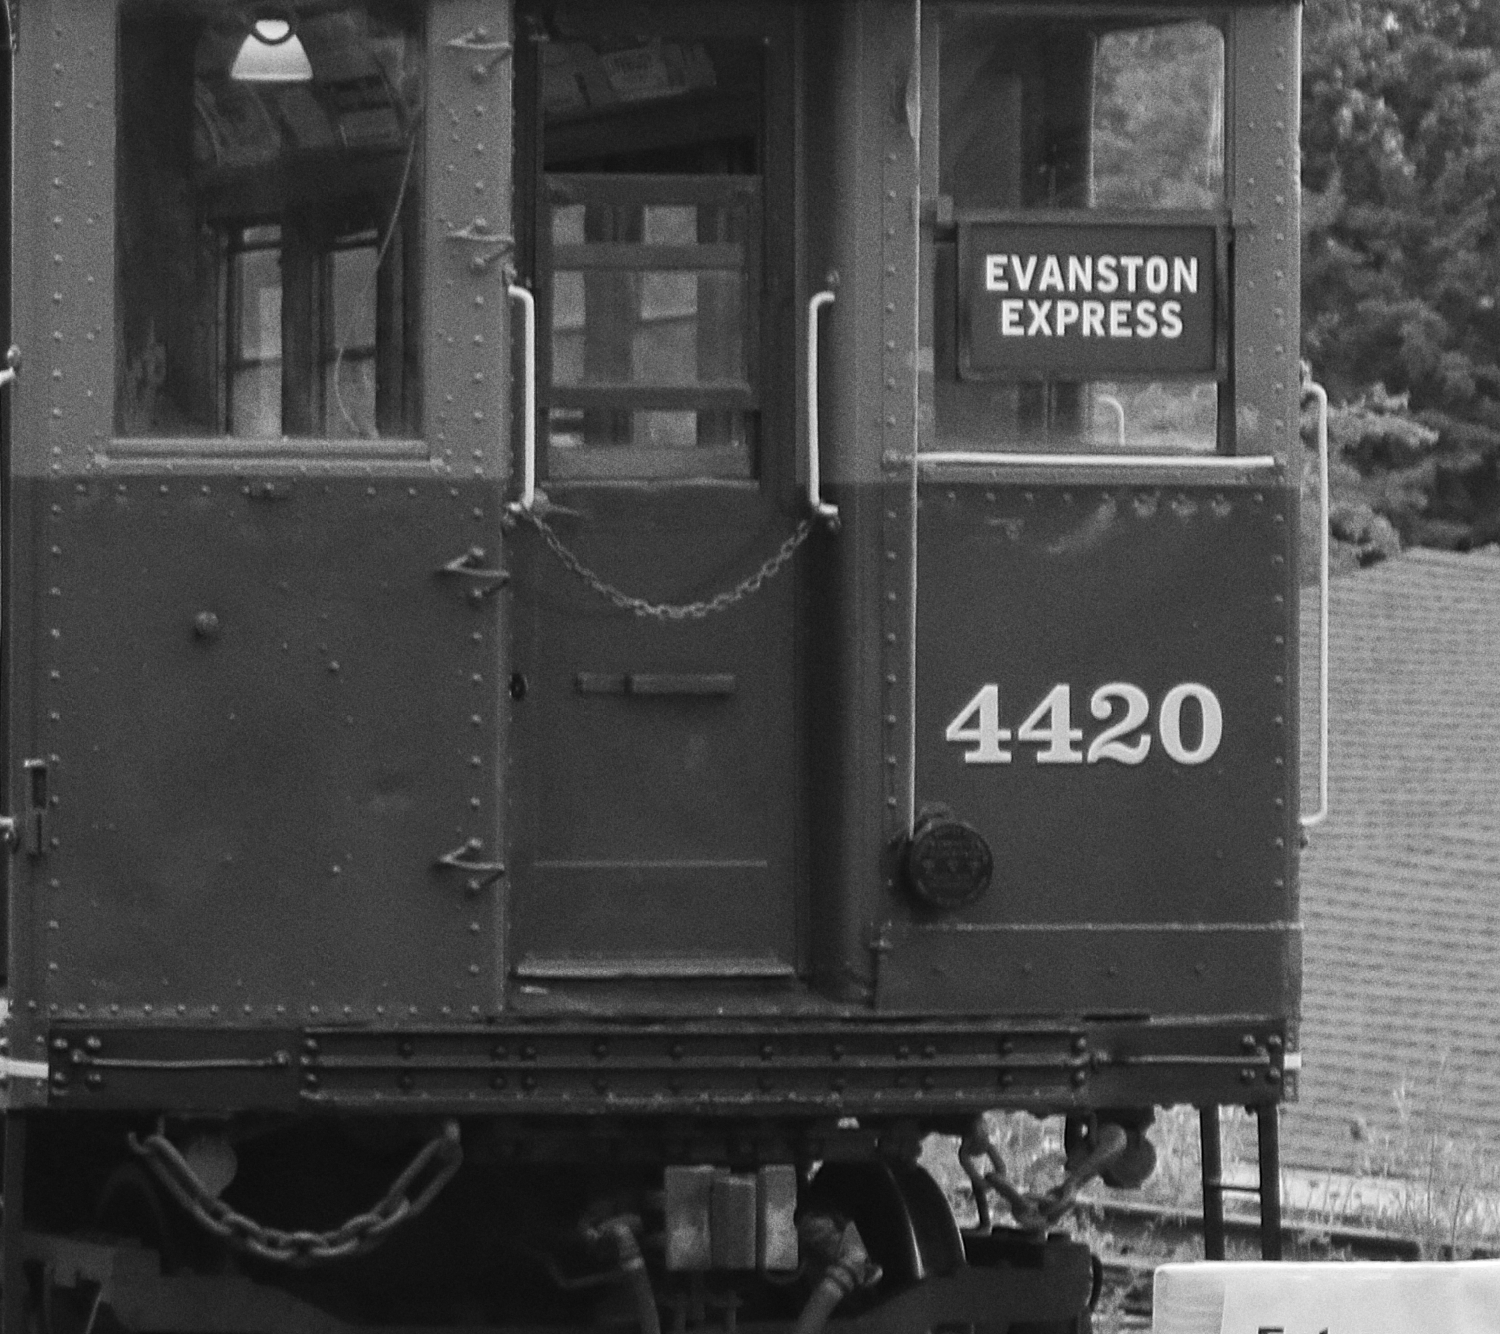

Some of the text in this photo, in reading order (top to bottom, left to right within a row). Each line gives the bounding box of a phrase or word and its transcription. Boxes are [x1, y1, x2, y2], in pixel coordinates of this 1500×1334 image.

[985, 254, 1198, 293] EVANSTON
[1001, 299, 1184, 338] EXPRESS
[946, 682, 1223, 764] 4420
